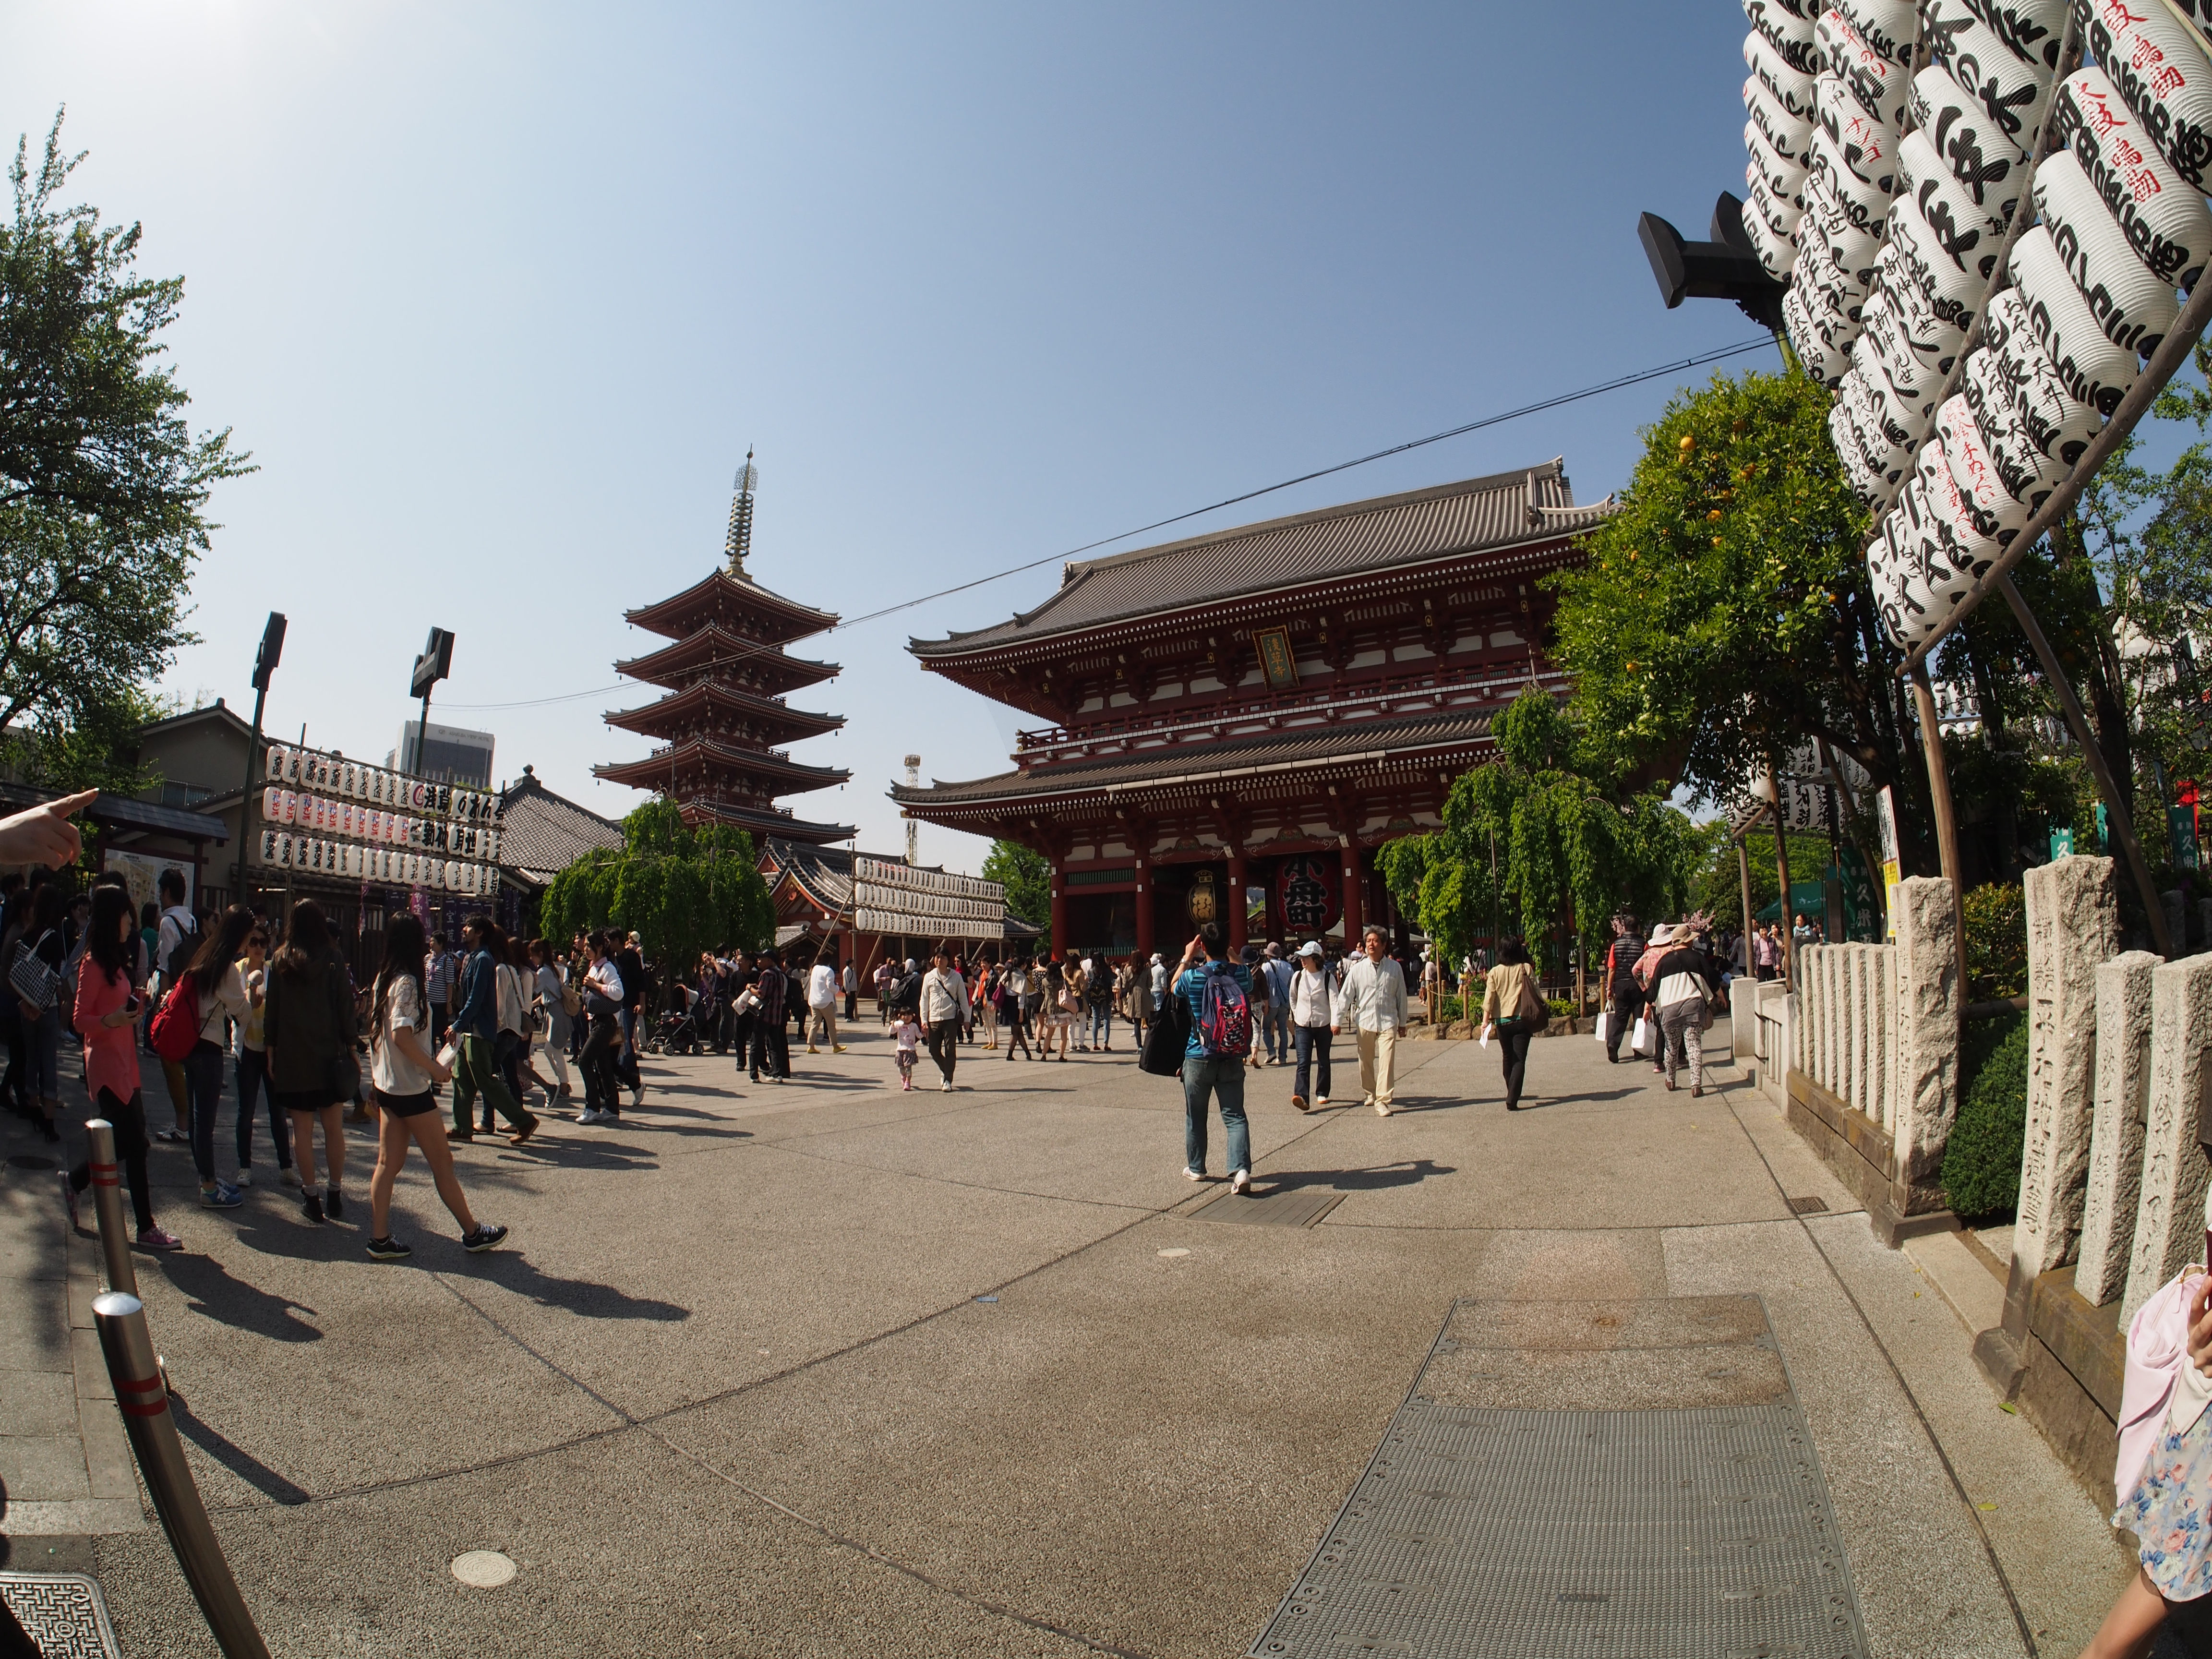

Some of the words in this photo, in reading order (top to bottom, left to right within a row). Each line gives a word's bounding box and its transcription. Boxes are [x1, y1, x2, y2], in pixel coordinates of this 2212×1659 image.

[1805, 176, 1847, 235] 仲見世
[1884, 252, 1937, 337] 新仲見世
[1873, 306, 1914, 384] 新仲見世
